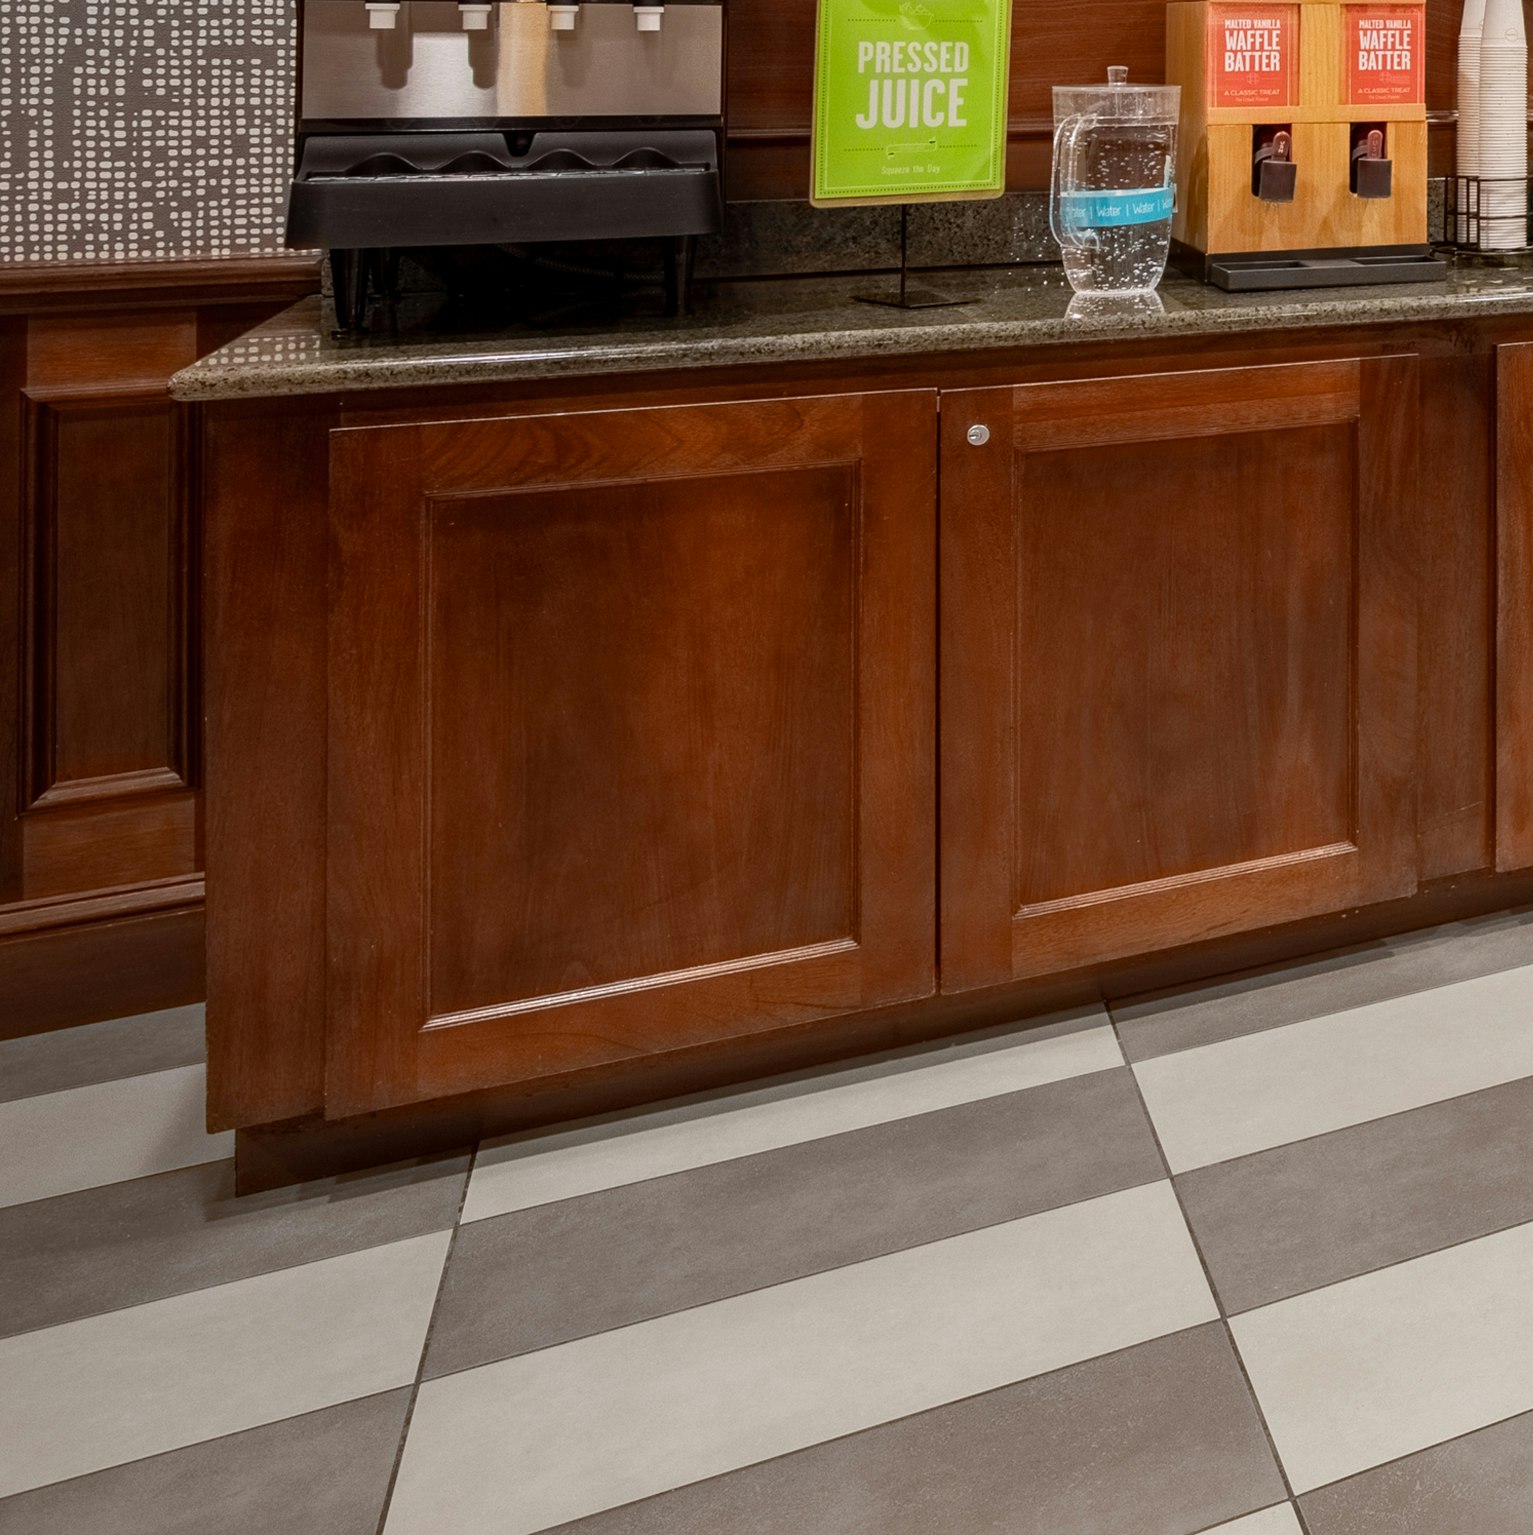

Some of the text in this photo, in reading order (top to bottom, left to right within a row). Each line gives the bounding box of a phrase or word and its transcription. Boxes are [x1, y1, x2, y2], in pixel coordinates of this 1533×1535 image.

[1225, 19, 1280, 29] MALTED VANILLA
[1359, 19, 1412, 29] MALTED VANILLA
[1225, 30, 1280, 50] WAFFLE
[1359, 30, 1412, 50] WAFFLE
[858, 41, 969, 73] PRESSED
[1224, 51, 1280, 72] BATTER
[1358, 51, 1411, 71] BATTER
[855, 78, 969, 129] JUICE
[881, 164, 941, 176] Squeeze the Day
[1096, 206, 1121, 217] Water
[1132, 202, 1155, 214] Water
